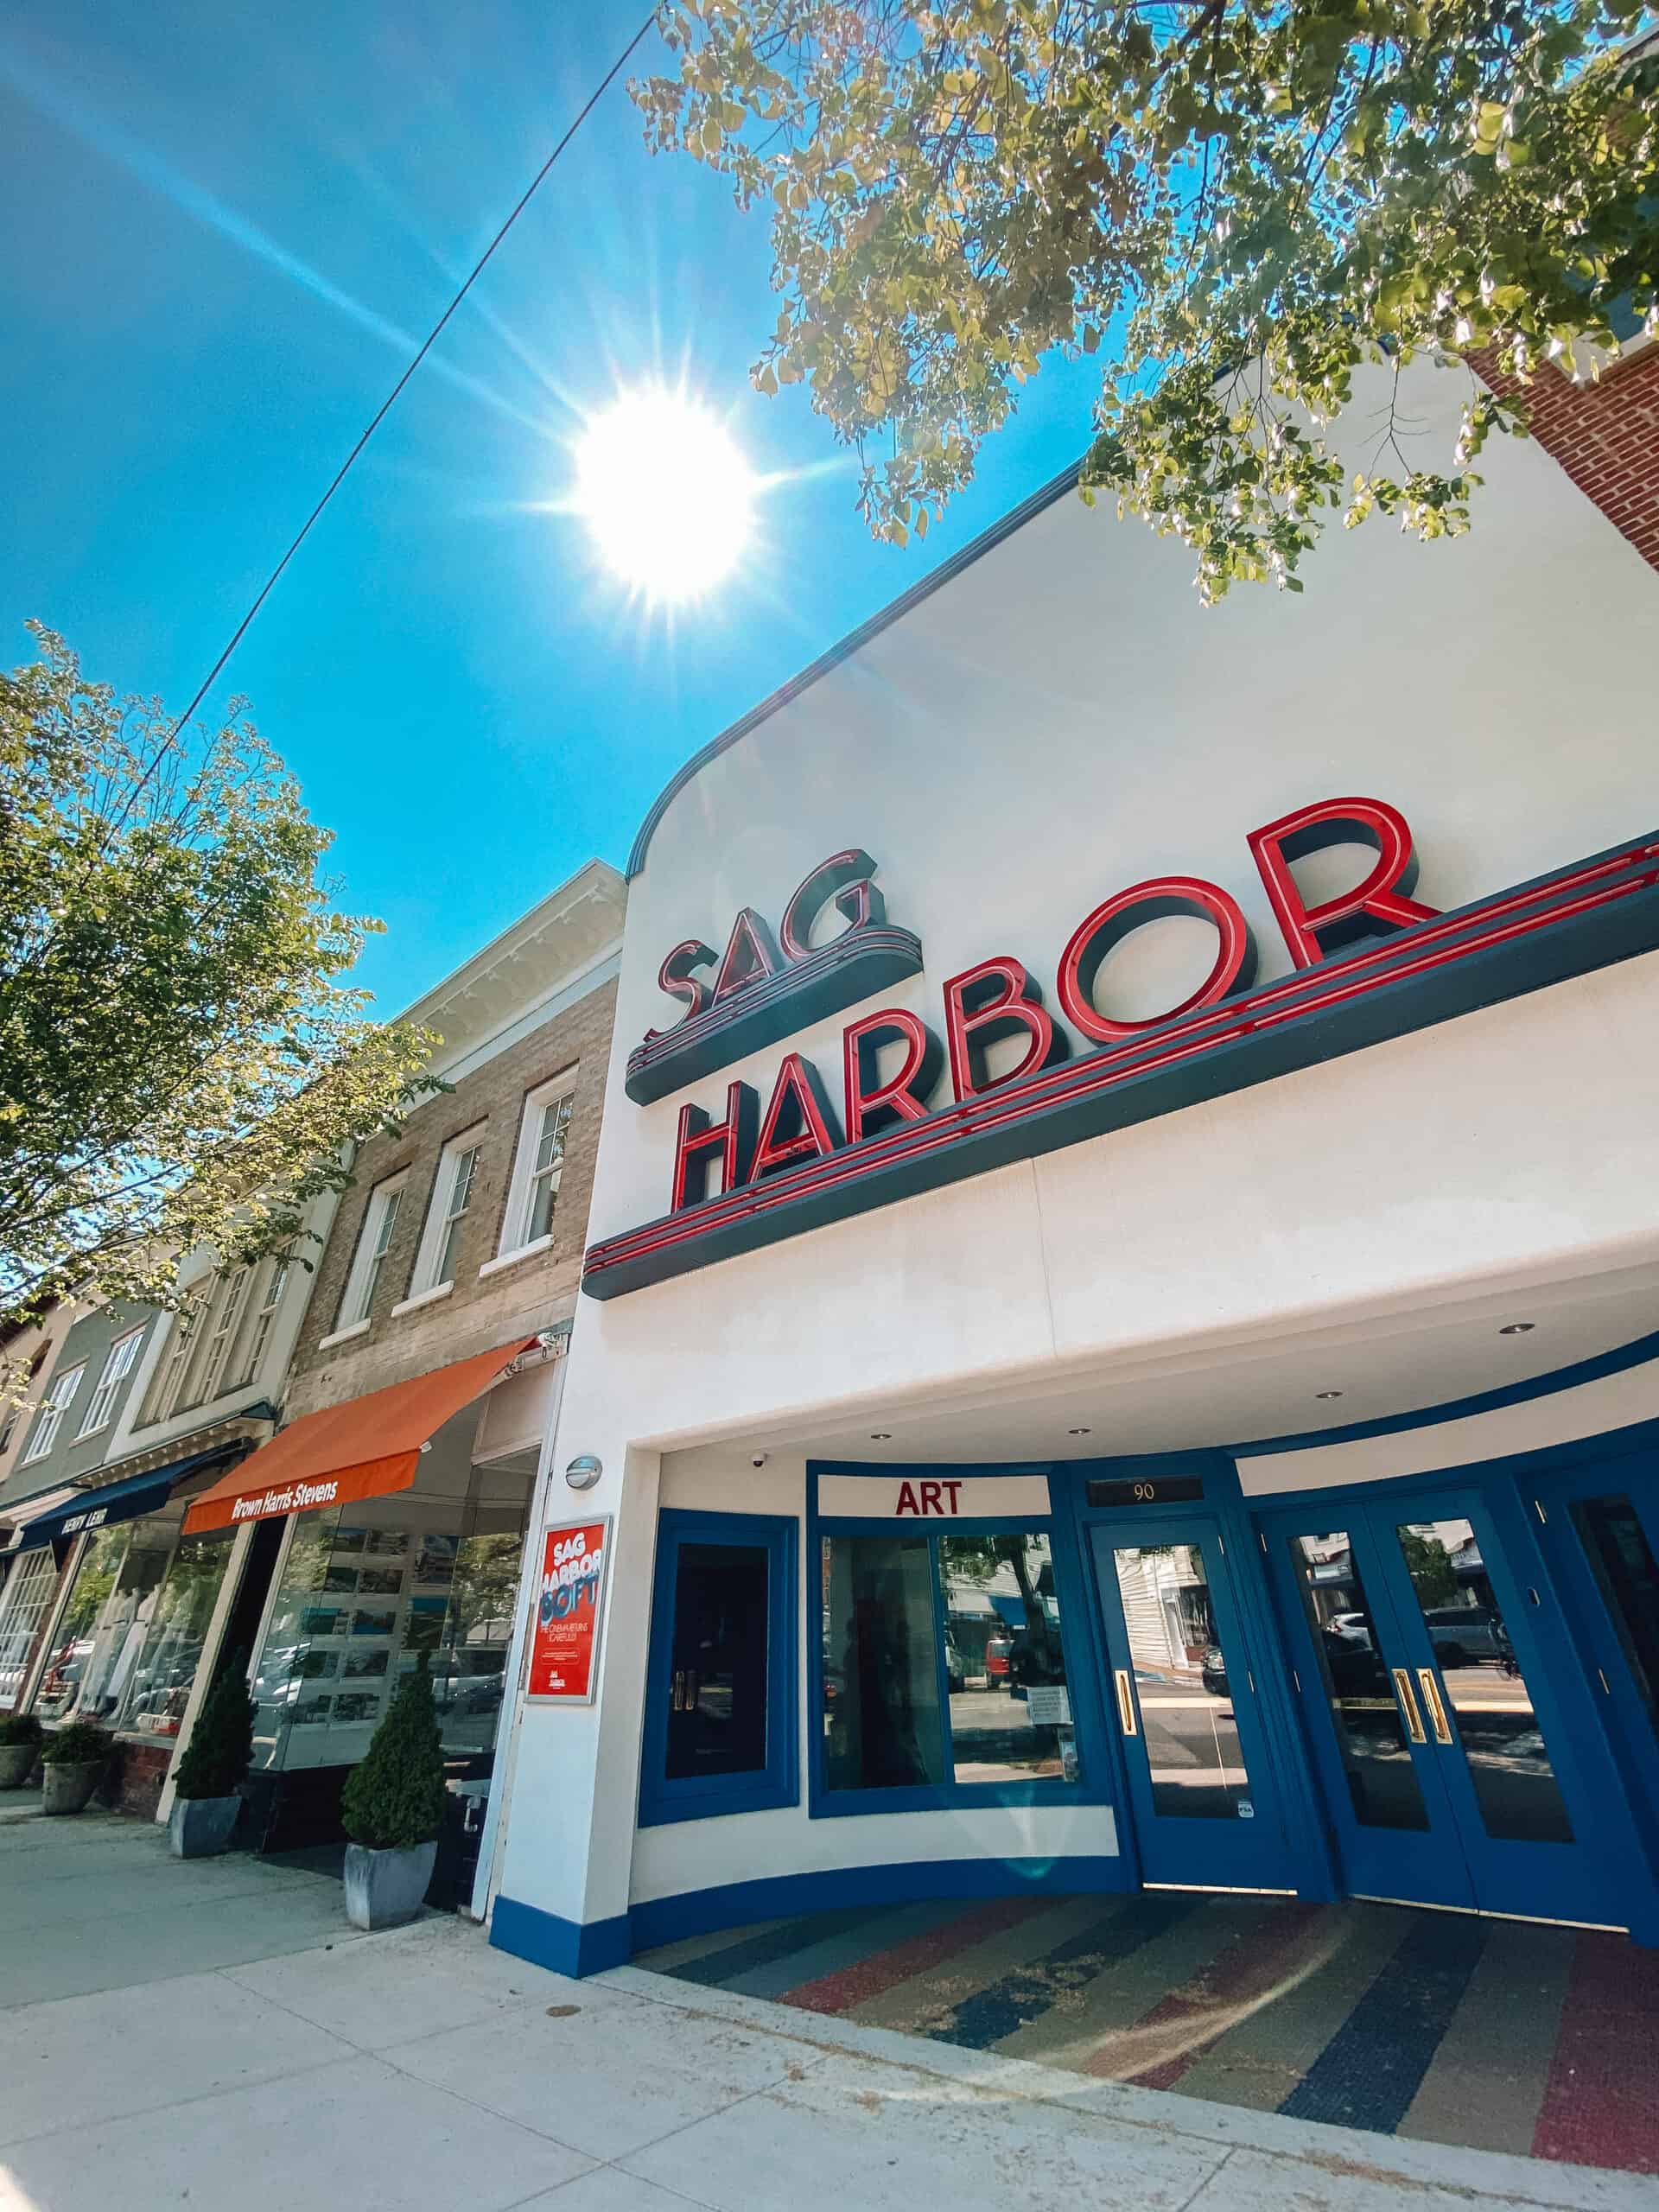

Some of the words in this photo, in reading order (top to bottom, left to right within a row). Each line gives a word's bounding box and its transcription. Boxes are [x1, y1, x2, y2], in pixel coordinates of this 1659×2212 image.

[643, 849, 887, 1043] SAG
[671, 796, 1442, 1213] HARBOR
[231, 1497, 264, 1521] Brown
[262, 1485, 294, 1514] Harris
[292, 1481, 339, 1508] Stevens
[896, 1481, 962, 1515] ART
[1134, 1484, 1154, 1500] 90
[553, 1532, 586, 1567] SAG
